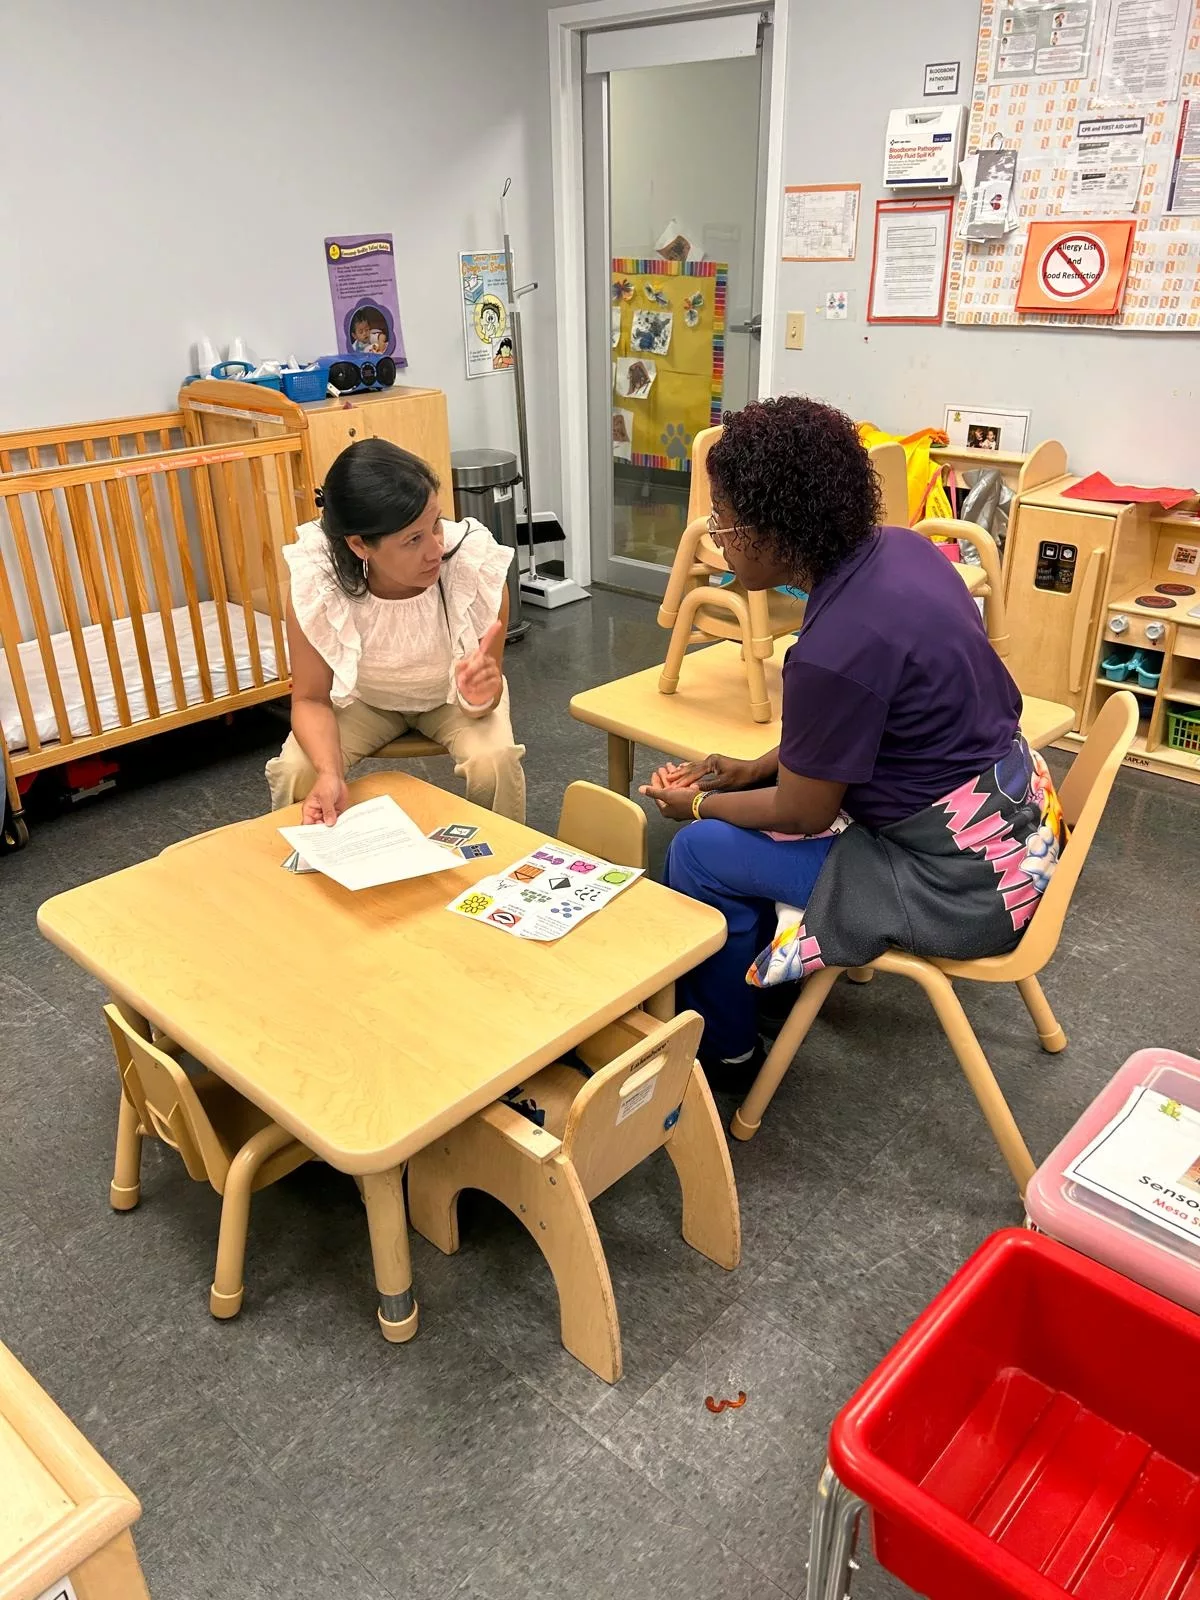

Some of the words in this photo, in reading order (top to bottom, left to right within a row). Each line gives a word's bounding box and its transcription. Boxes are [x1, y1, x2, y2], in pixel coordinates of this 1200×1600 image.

[1058, 243, 1083, 252] Allergy
[1084, 243, 1097, 251] List
[1067, 257, 1082, 265] And
[1043, 271, 1061, 279] Food
[1062, 271, 1101, 279] Restriction
[1138, 1175, 1200, 1212] Senso
[1152, 1198, 1188, 1220] Mesa
